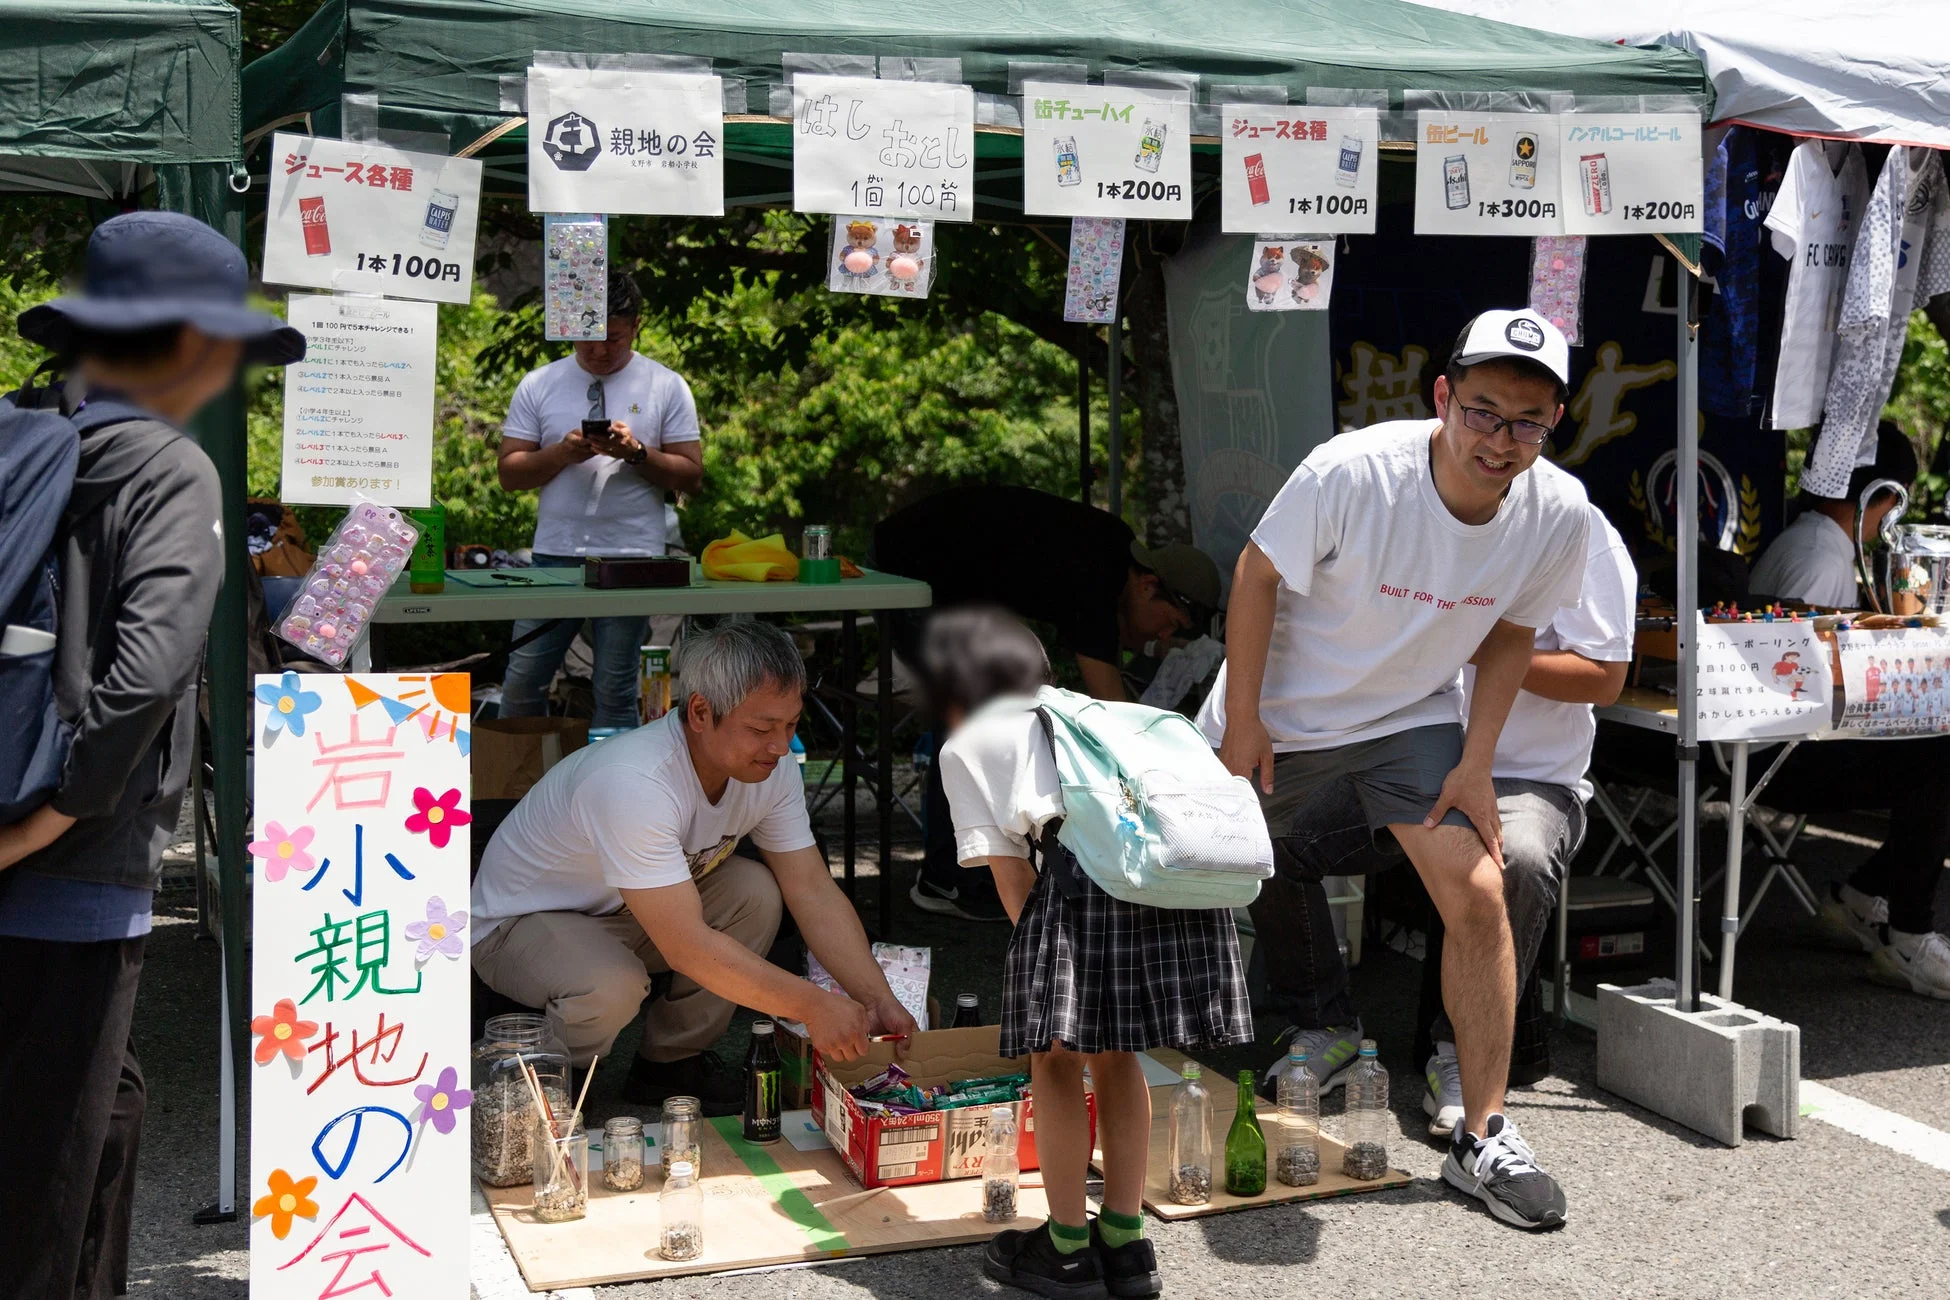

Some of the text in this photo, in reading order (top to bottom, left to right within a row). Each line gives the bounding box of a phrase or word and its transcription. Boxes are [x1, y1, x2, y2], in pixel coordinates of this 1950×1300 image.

[800, 94, 870, 140] はし
[1034, 98, 1135, 124] 缶チューハイ
[1232, 118, 1328, 141] ジュース各種
[1426, 124, 1489, 145] 缶ビール
[1568, 126, 1682, 141] ノンアルコールビール
[610, 127, 716, 158] 親地の会
[879, 119, 968, 169] おとし
[285, 152, 415, 192] ジュース各種
[630, 159, 652, 168] 交野市
[851, 181, 957, 211] 1回 100円
[1097, 180, 1181, 201] 1本200円
[430, 207, 454, 222] CALPIS
[1289, 195, 1368, 215] 1本100円
[1478, 199, 1556, 219] 1本300円
[1623, 201, 1695, 220] 1本200円
[428, 218, 450, 230] WATER
[357, 253, 461, 282] 1本100円
[1380, 583, 1496, 610] BUILT FOR THE ISSION
[277, 713, 434, 1300] 岩小親地の会
[950, 1130, 986, 1156] ahi
[958, 1155, 984, 1169] RY
